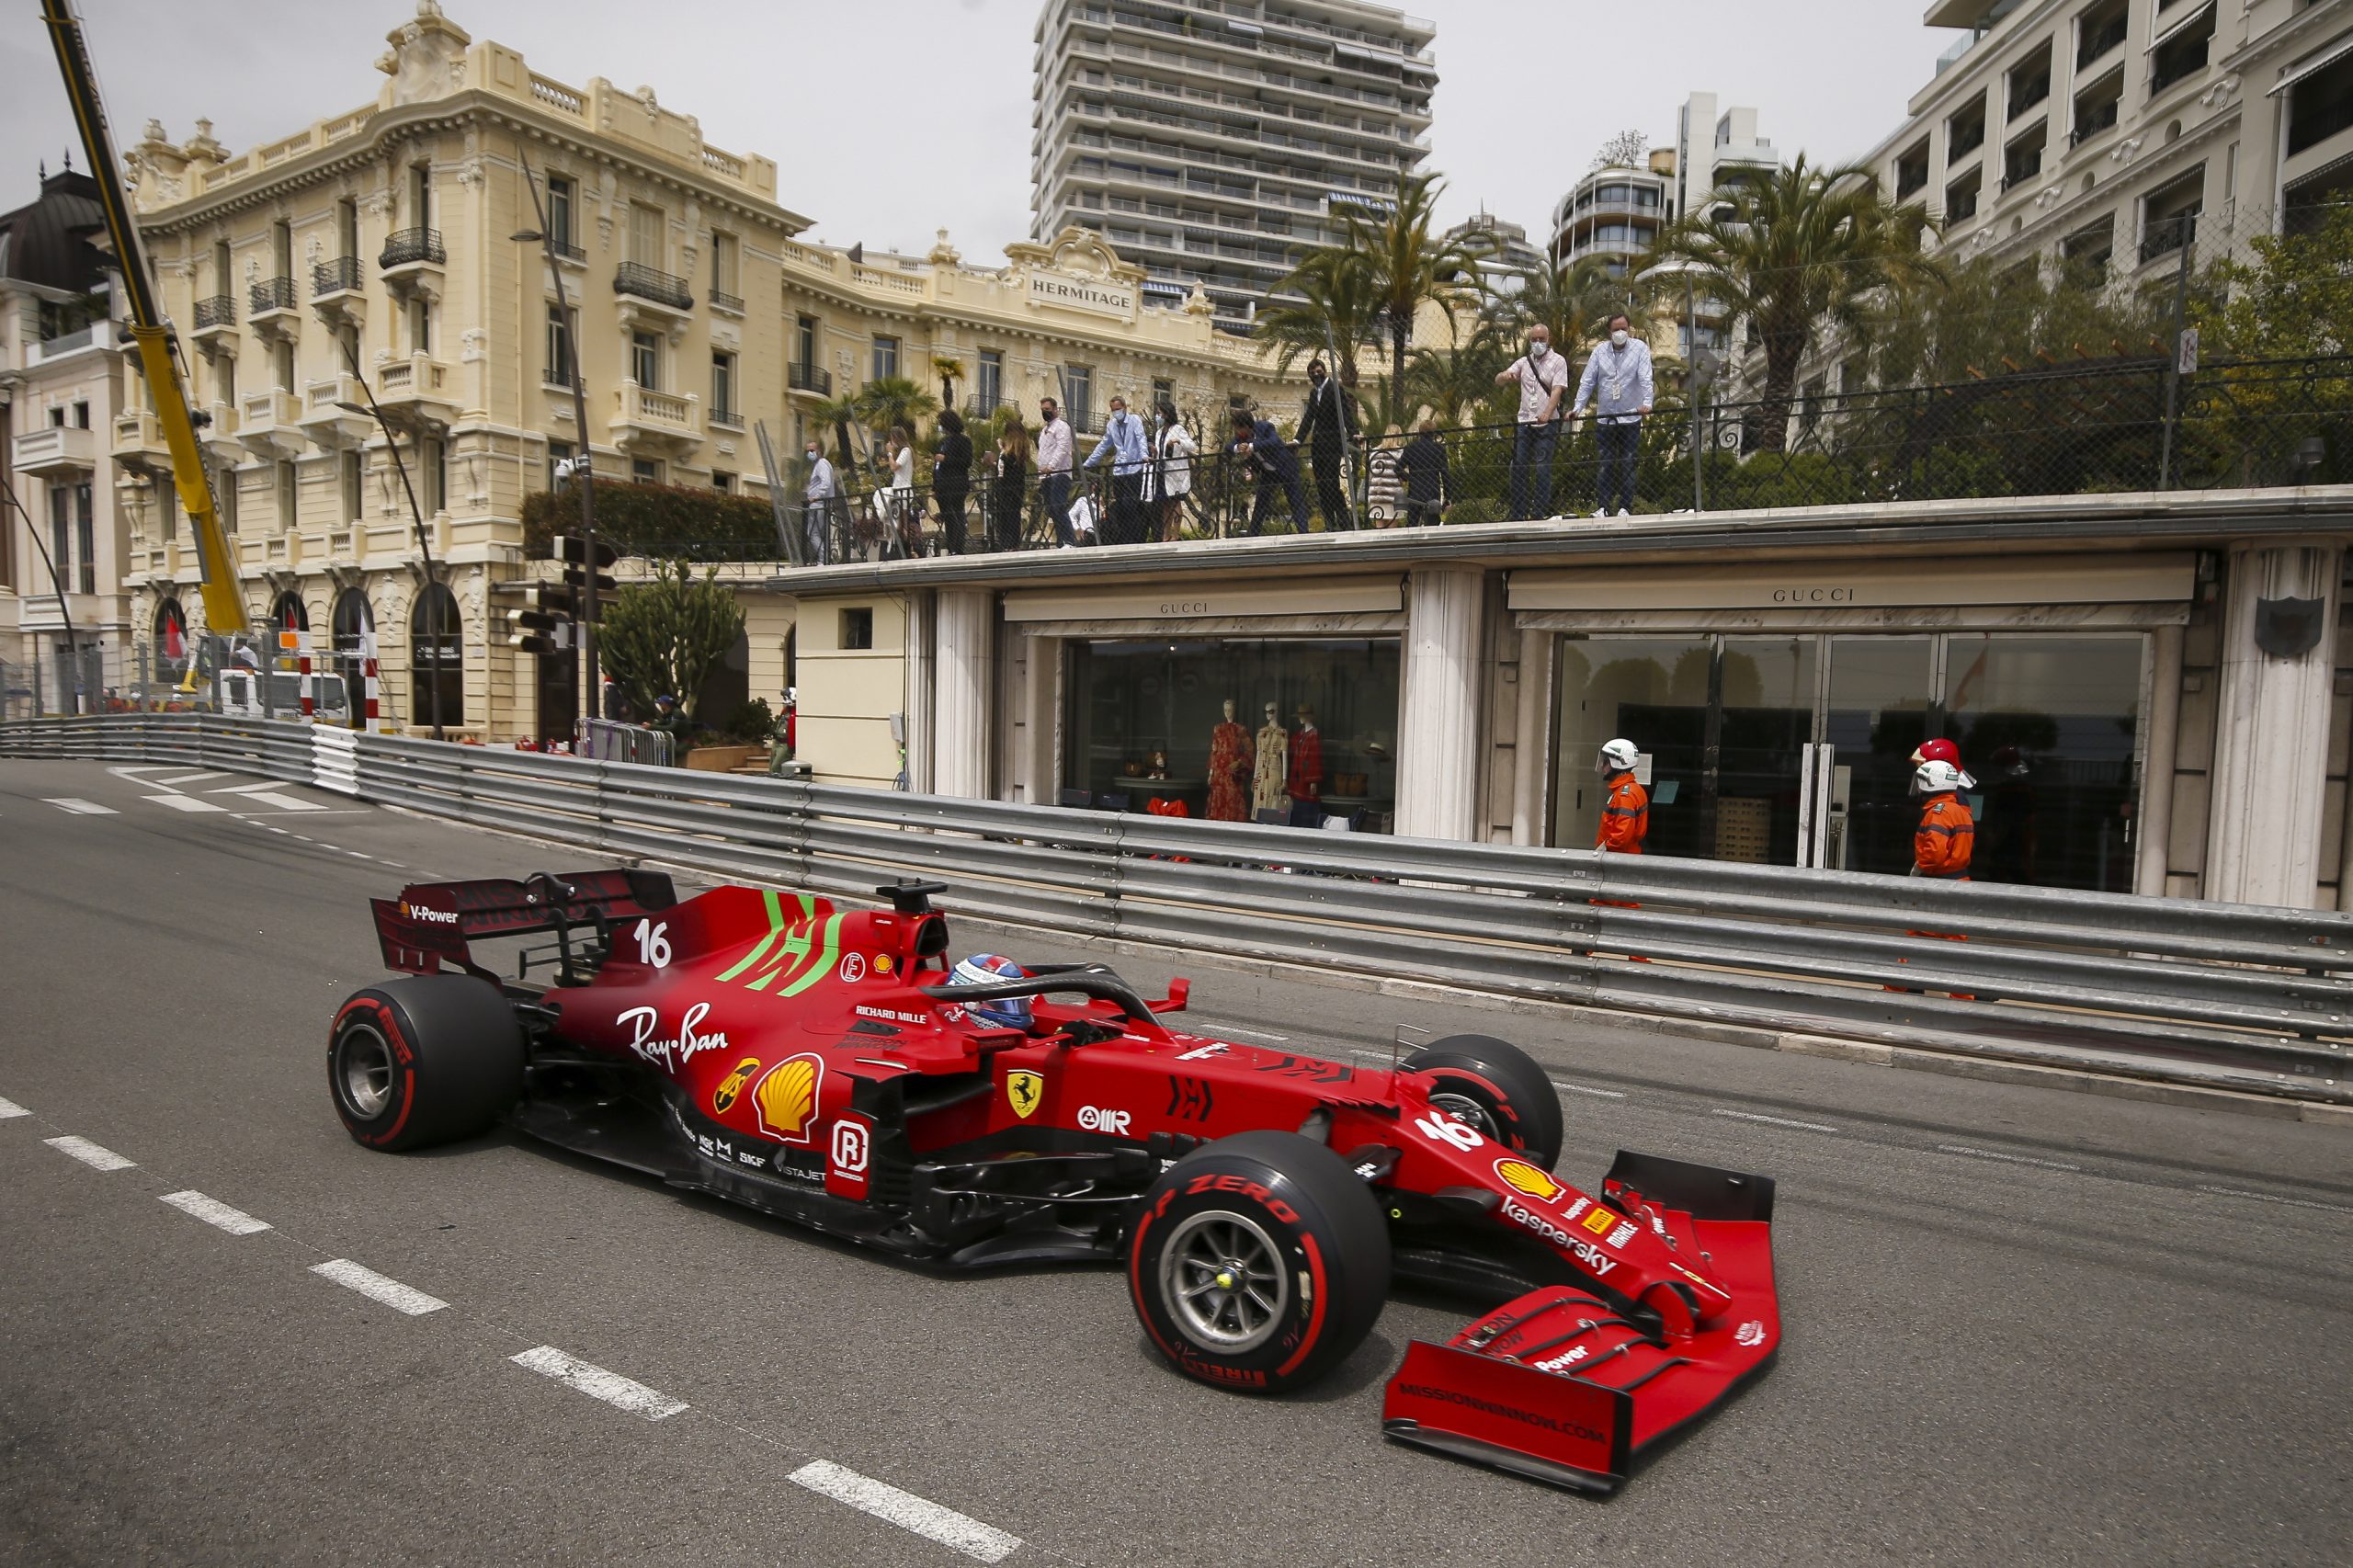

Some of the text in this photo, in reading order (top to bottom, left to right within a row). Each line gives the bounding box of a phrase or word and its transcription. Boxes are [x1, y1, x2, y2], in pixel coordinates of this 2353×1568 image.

[1032, 279, 1131, 309] HERMITAGE
[1160, 602, 1208, 614] GUCCI
[1773, 588, 1854, 602] GUCCI
[410, 905, 460, 924] V-Power
[633, 918, 672, 968] 16
[856, 1006, 927, 1024] RICHARD MILLE
[719, 1072, 747, 1105] ups
[699, 1133, 714, 1152] NGK
[1415, 1111, 1484, 1153] 16
[739, 1152, 766, 1167] SKF
[776, 1162, 826, 1181] VISTAJET
[1153, 1187, 1176, 1219] P
[1186, 1174, 1301, 1224] ZERO
[1501, 1195, 1619, 1276] kaspersky
[1606, 1221, 1640, 1249] MAHLE
[1398, 1382, 1607, 1444] MISSIONWINNOW.COM
